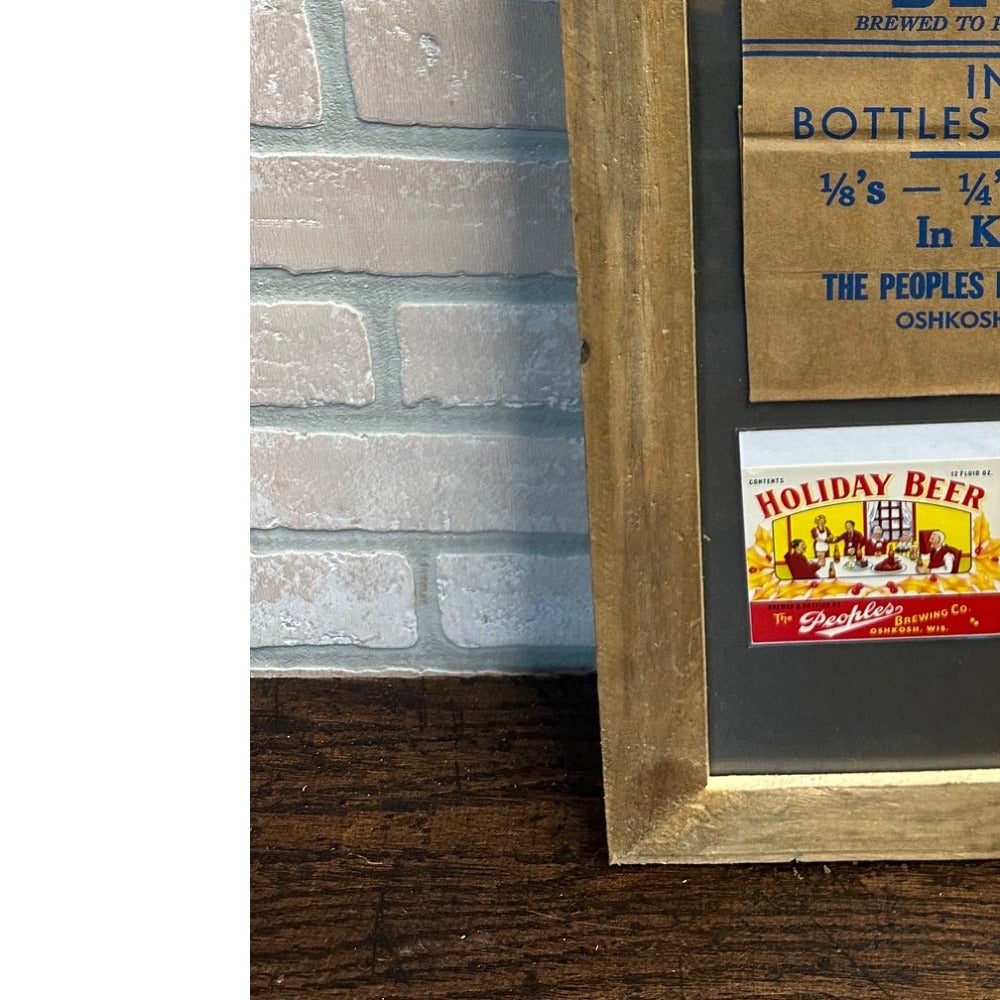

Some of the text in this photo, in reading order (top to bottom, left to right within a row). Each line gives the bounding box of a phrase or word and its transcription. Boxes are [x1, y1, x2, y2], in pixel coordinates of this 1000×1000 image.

[855, 15, 949, 32] BREWED
[956, 15, 986, 32] TO
[794, 106, 990, 140] BOTTLES
[916, 215, 953, 249] In
[822, 272, 868, 301] THE
[880, 271, 984, 300] PEOPLES
[749, 477, 785, 485] CONTENTS
[755, 470, 987, 519] HOLIDAY BEER
[798, 601, 904, 634] Peoples
[894, 608, 949, 626] BREWING
